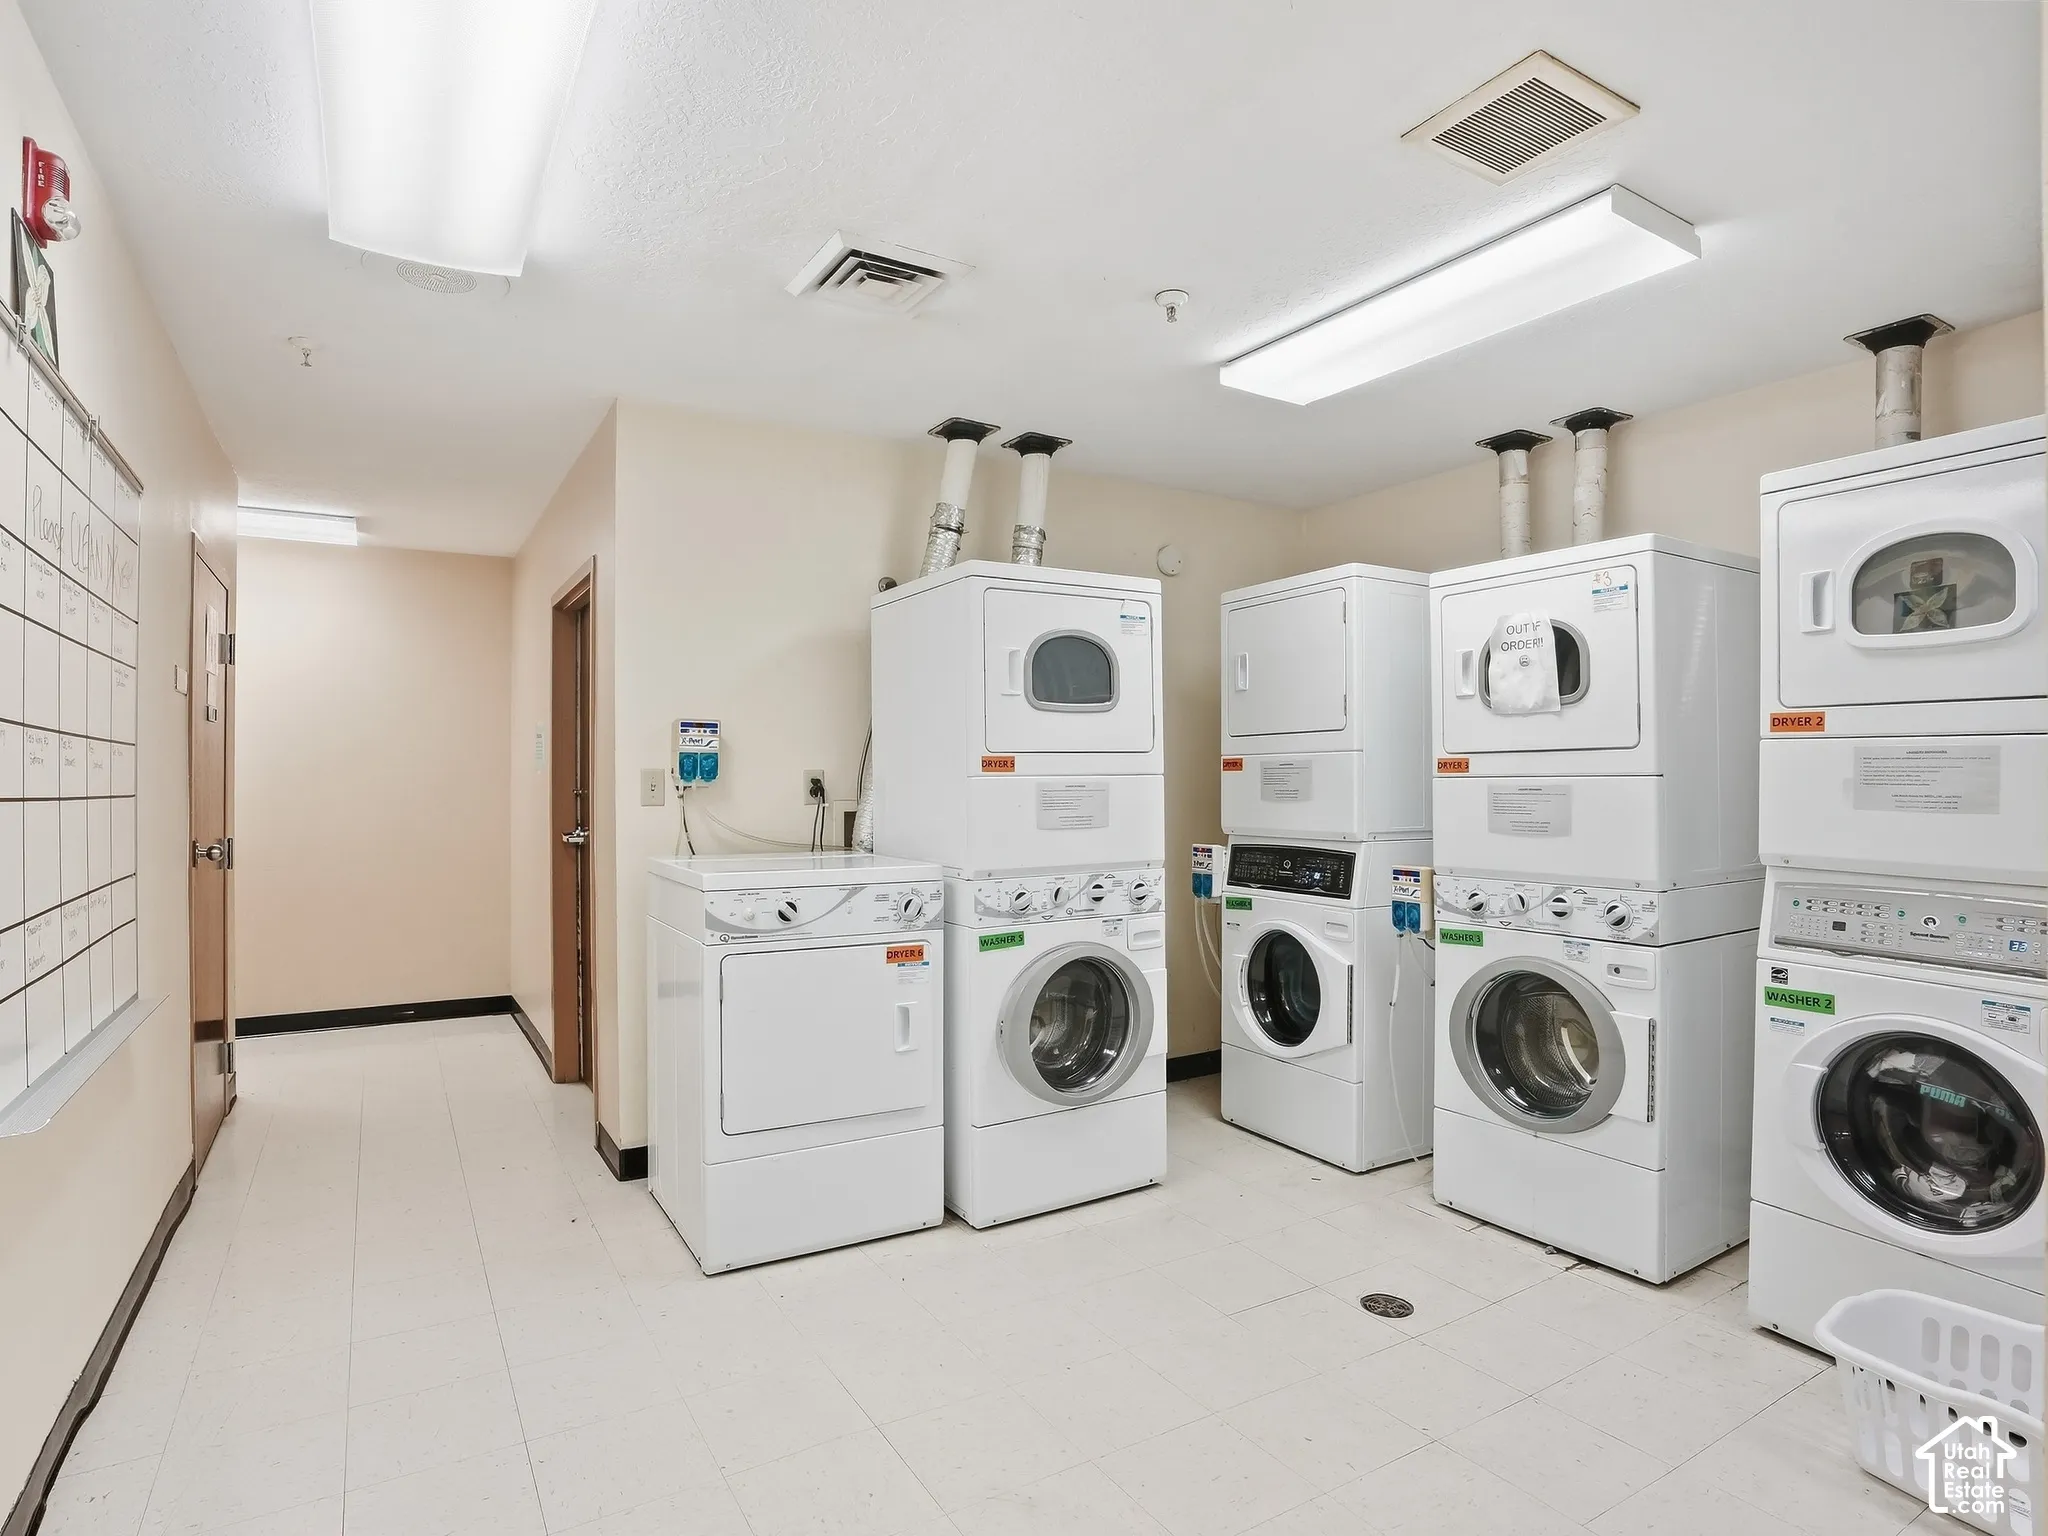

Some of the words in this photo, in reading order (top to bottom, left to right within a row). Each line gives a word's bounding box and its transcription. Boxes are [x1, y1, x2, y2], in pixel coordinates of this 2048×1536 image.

[1506, 623, 1530, 635] OUT
[1772, 717, 1812, 727] DRYER
[1816, 716, 1823, 726] 2
[982, 760, 1008, 768] DRYER
[1437, 761, 1462, 769] DRYER
[1464, 761, 1469, 769] 3
[980, 936, 1016, 947] WASHER
[1441, 932, 1475, 943] WASHER
[1476, 935, 1481, 943] 3
[887, 949, 916, 960] DRYER
[917, 948, 924, 957] 6
[1766, 991, 1821, 1008] WASHER
[1824, 998, 1832, 1009] 2
[1920, 1084, 1966, 1108] PUMA
